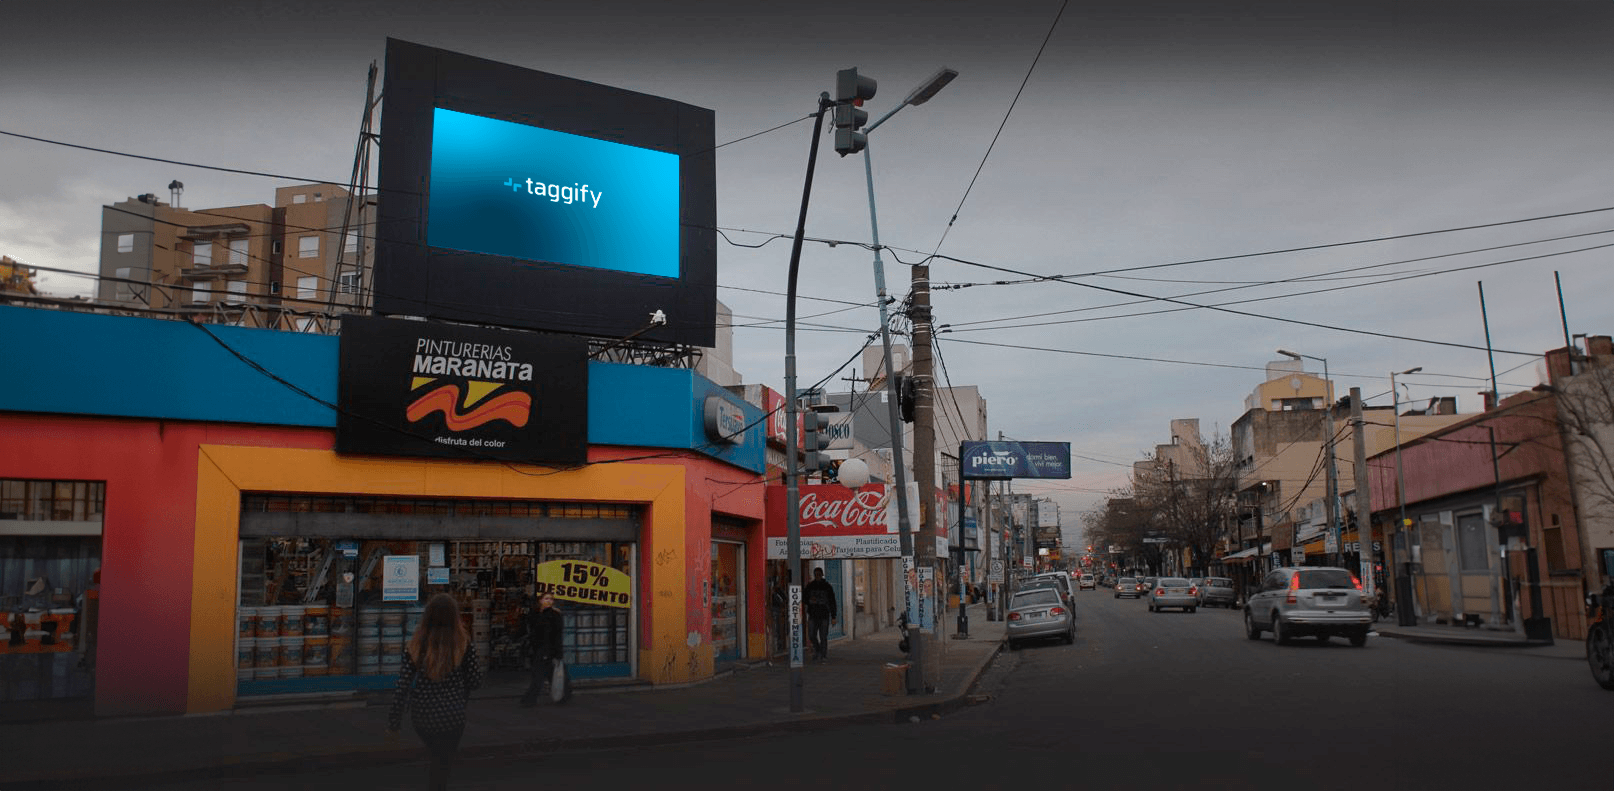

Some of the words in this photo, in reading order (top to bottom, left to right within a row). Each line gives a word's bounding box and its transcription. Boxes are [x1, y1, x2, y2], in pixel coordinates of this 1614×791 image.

[525, 177, 602, 208] taggify
[416, 338, 512, 361] PINTURERIAS
[435, 436, 467, 446] disfruta
[469, 438, 482, 447] del
[484, 439, 505, 447] color
[972, 451, 1016, 468] piero
[836, 547, 863, 555] Tarjetas
[855, 538, 898, 546] Plastificado
[561, 562, 609, 588] 15%
[536, 582, 629, 604] DESCUENTO
[791, 587, 800, 662] UGARTEMENDIA
